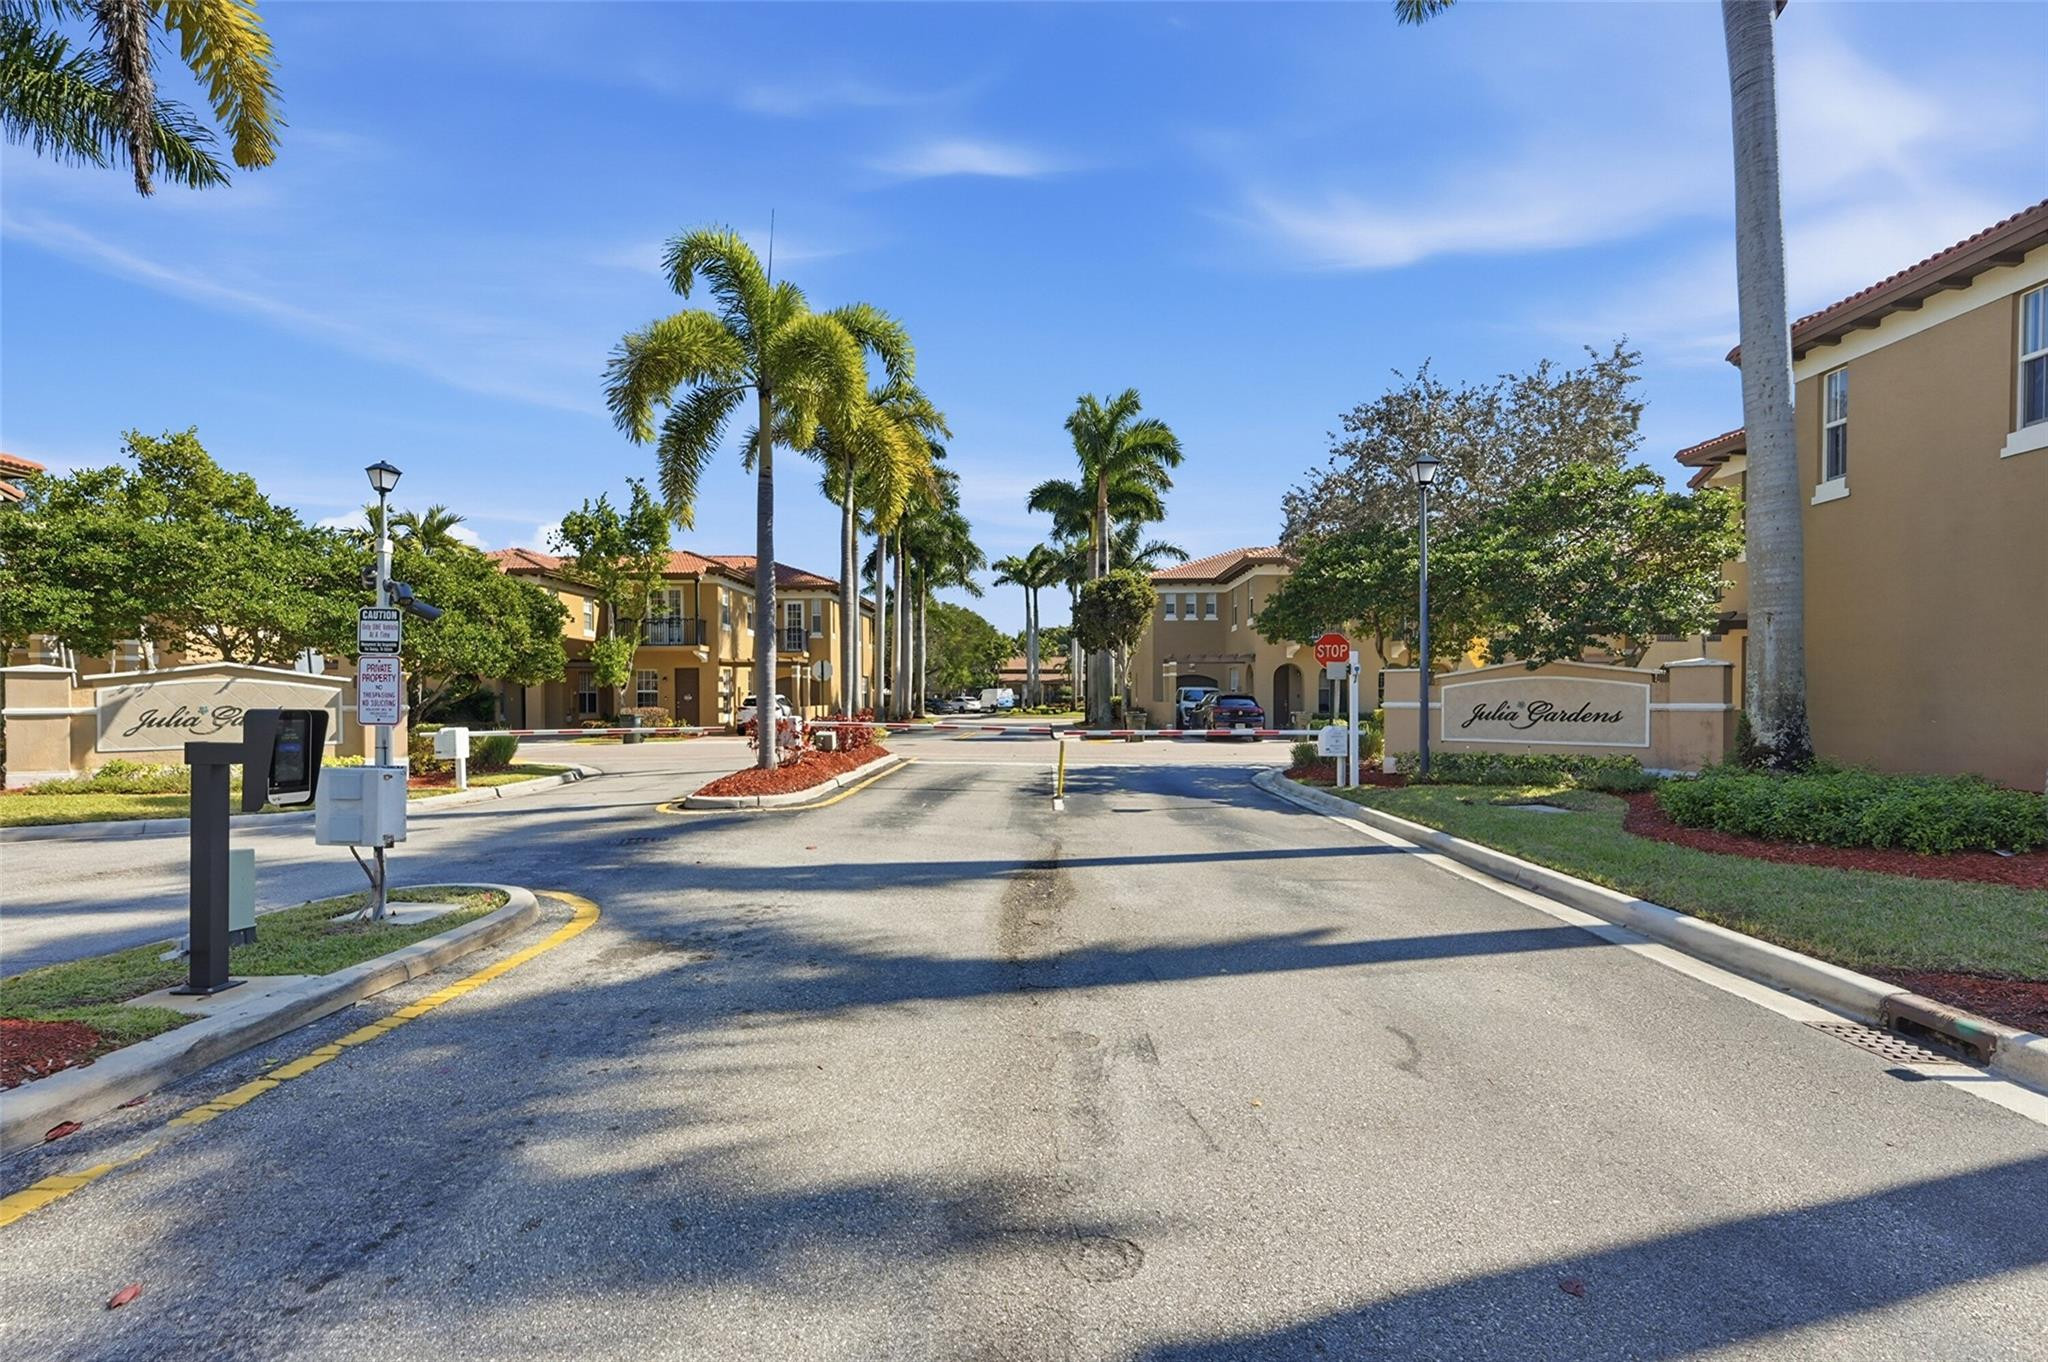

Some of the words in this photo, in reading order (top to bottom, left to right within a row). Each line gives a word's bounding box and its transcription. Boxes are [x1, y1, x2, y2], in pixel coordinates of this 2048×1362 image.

[362, 610, 397, 620] CAUTION
[1316, 644, 1348, 658] STOP
[366, 664, 392, 672] PRIVATE
[362, 674, 396, 682] PROPERTY
[122, 705, 202, 737] Julia
[1461, 700, 1520, 729] Julia
[1509, 700, 1624, 730] Gardens
